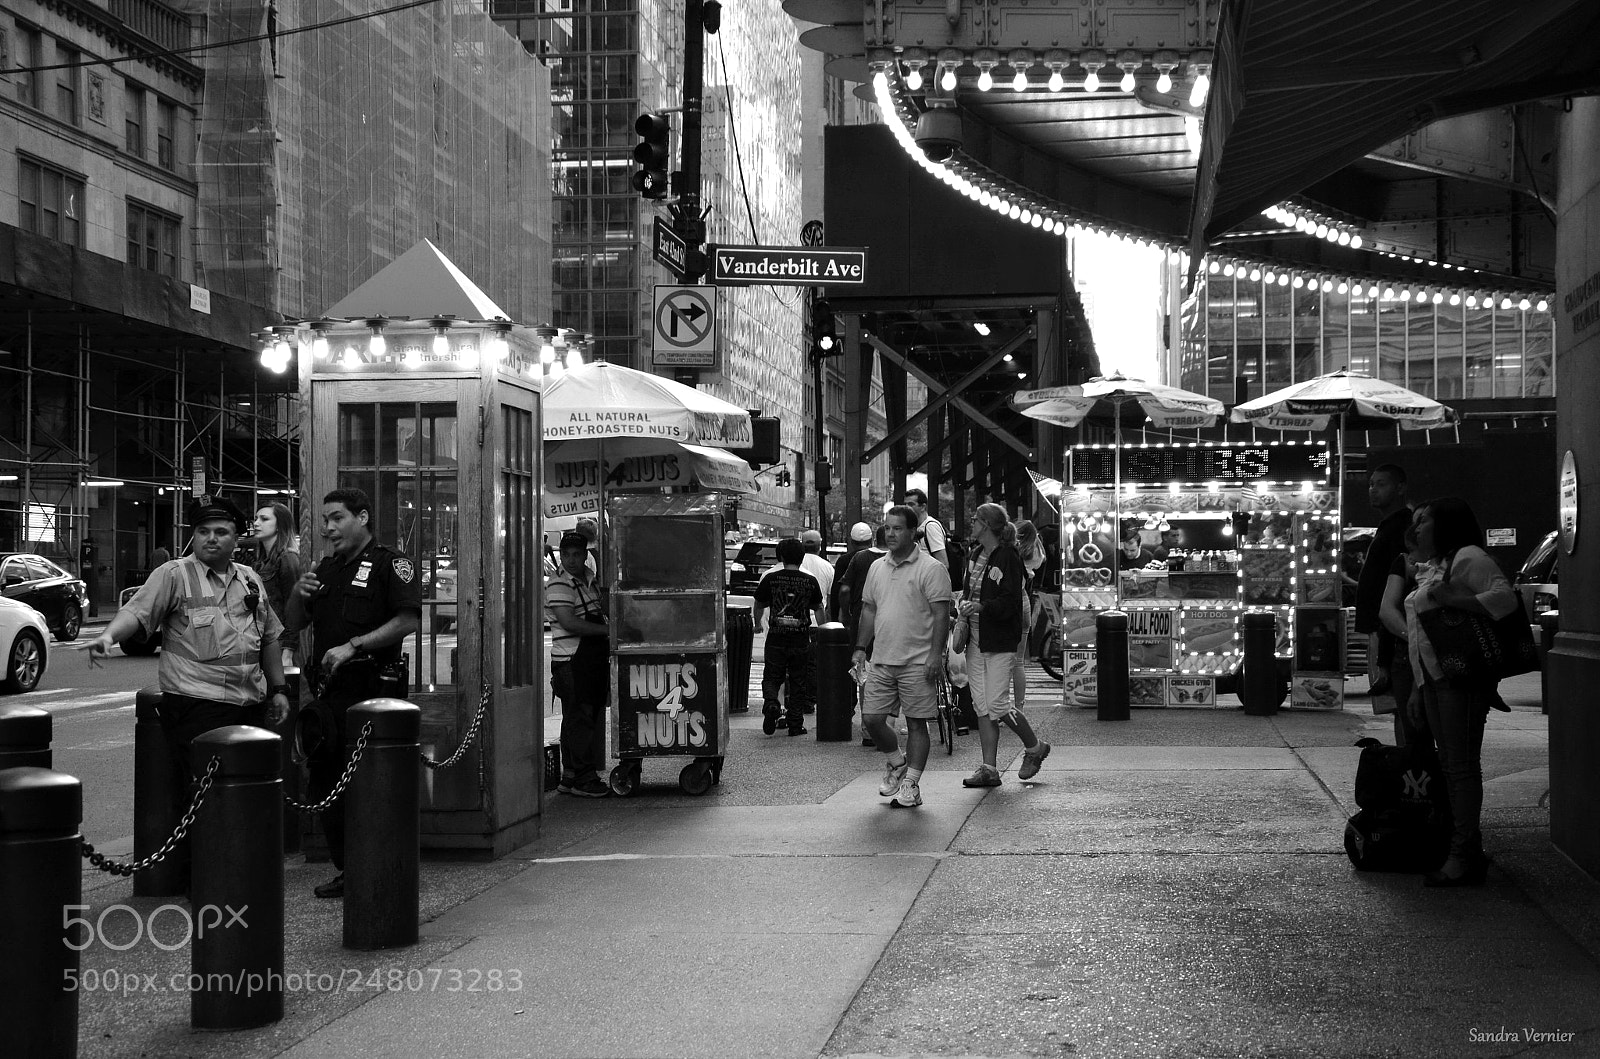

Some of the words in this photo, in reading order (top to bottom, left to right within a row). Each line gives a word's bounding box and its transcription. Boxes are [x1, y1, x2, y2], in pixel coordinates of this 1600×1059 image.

[659, 231, 669, 255] East
[719, 256, 819, 276] Vanderbilt
[823, 259, 861, 276] Ave
[569, 412, 591, 422] ALL
[596, 412, 651, 422] NATURAL
[1244, 406, 1274, 419] SABRETT
[1374, 404, 1425, 416] SABRETT
[542, 424, 644, 437] HONEY-ROASTED
[649, 425, 680, 436] NUTS
[85, 547, 91, 555] P
[1127, 612, 1147, 635] ALAL
[1149, 612, 1170, 635] FOOD
[1069, 652, 1090, 660] CHILI
[629, 663, 698, 699] NUTS
[656, 686, 684, 720] 4
[637, 711, 706, 748] NUTS
